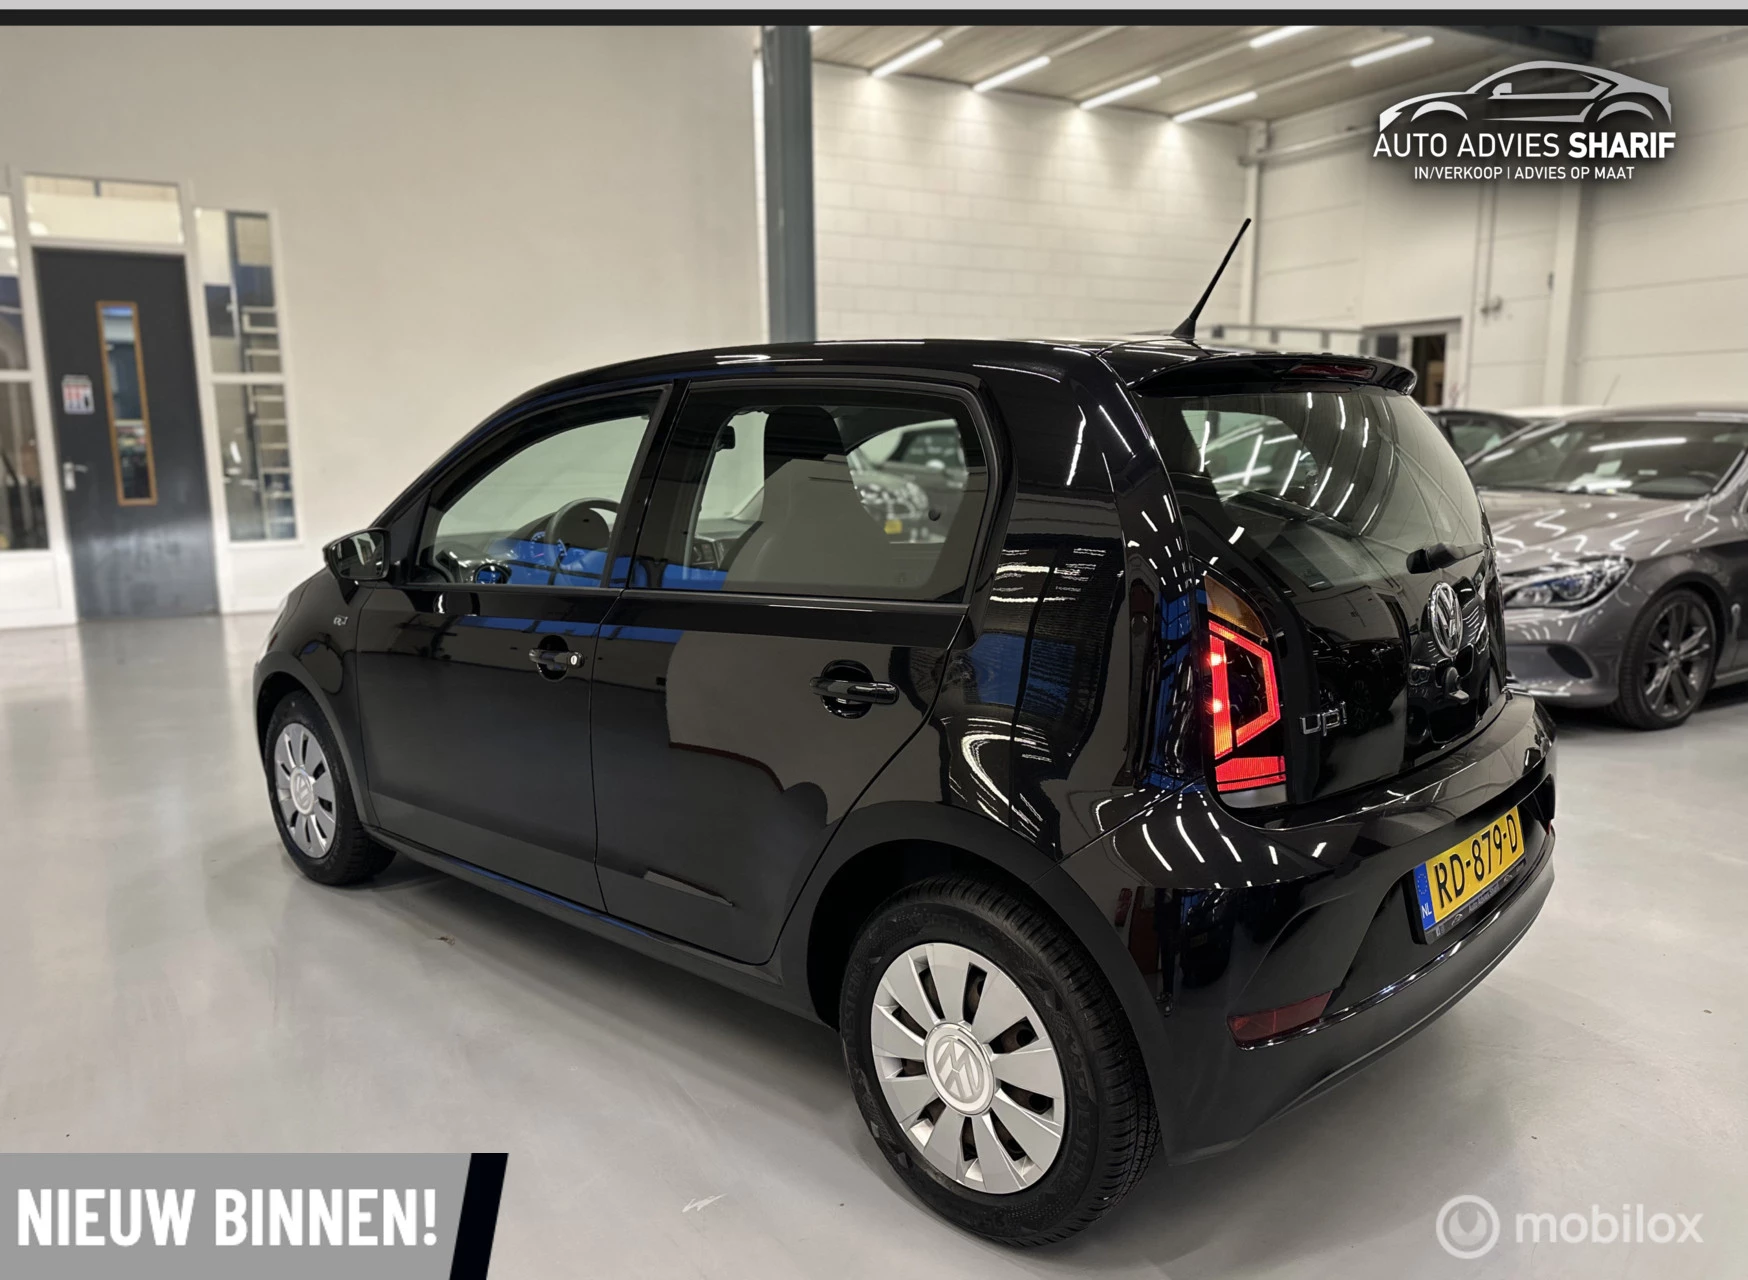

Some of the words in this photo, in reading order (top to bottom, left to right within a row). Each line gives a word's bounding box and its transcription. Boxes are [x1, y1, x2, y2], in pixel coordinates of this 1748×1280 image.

[1299, 700, 1348, 737] up!
[1433, 813, 1518, 910] RD-879-D
[1421, 902, 1432, 919] NL
